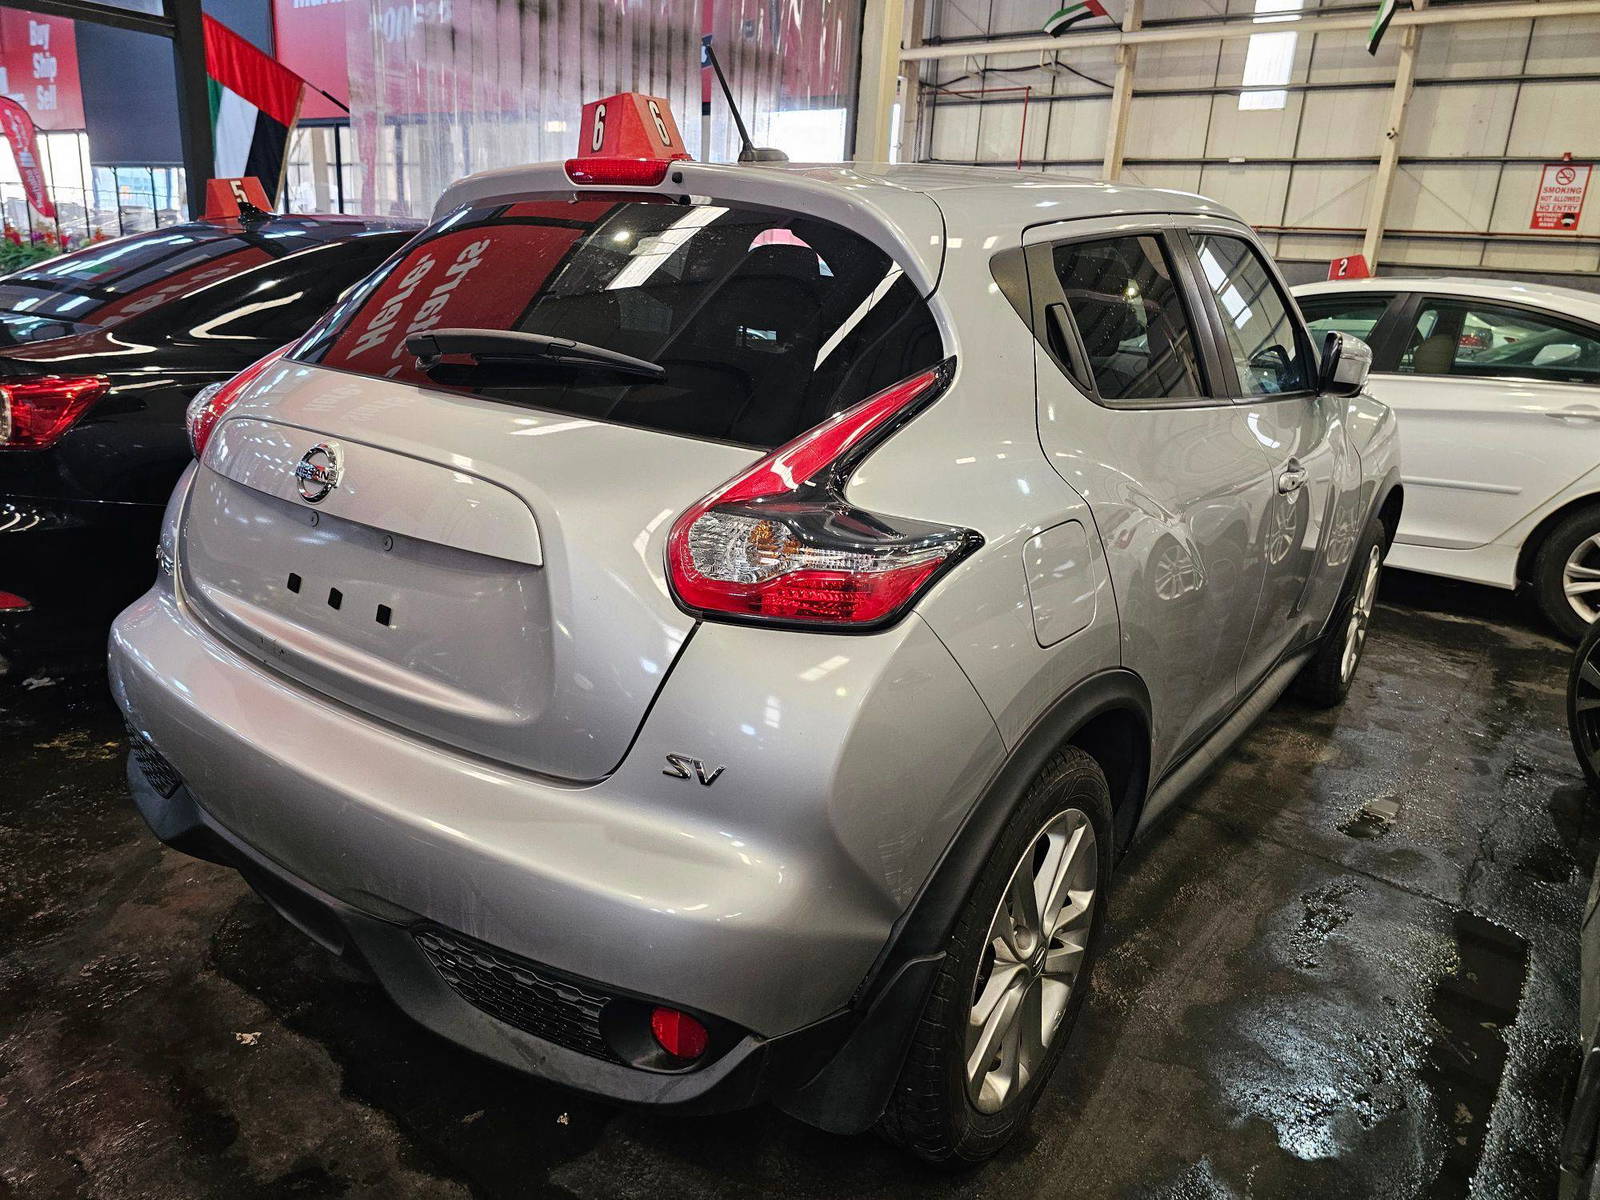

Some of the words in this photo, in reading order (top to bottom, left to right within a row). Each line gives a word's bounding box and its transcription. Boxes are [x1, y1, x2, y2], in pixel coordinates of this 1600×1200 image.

[592, 104, 607, 152] 6
[648, 100, 670, 146] 6
[230, 180, 246, 203] 5
[1338, 258, 1348, 276] 2
[296, 465, 330, 481] NISSAN
[662, 752, 727, 786] SV
